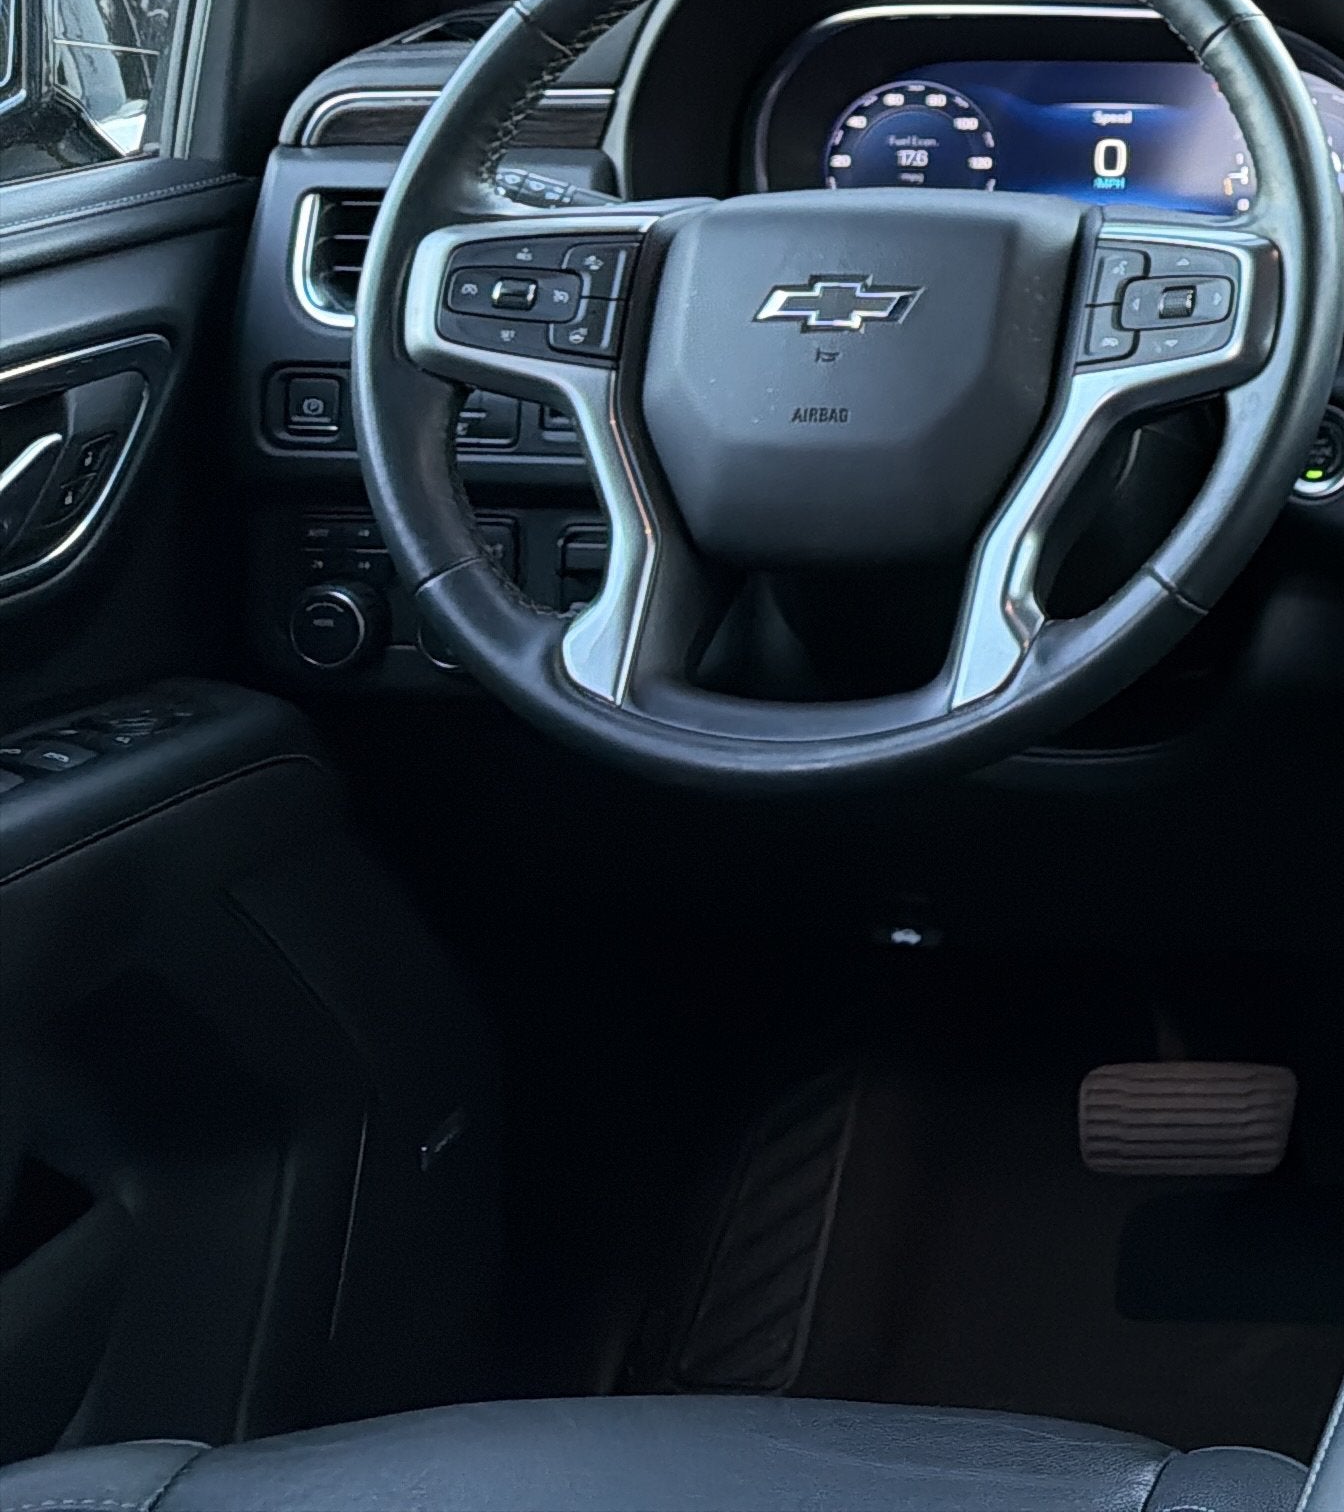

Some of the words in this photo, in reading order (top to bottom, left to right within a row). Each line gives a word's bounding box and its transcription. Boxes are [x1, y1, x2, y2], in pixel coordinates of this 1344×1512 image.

[953, 117, 979, 131] 100
[1092, 110, 1133, 126] Speed
[888, 135, 911, 147] Fuel
[913, 136, 940, 147] Econ.
[1094, 138, 1127, 178] 0
[791, 407, 849, 423] AIRBAG
